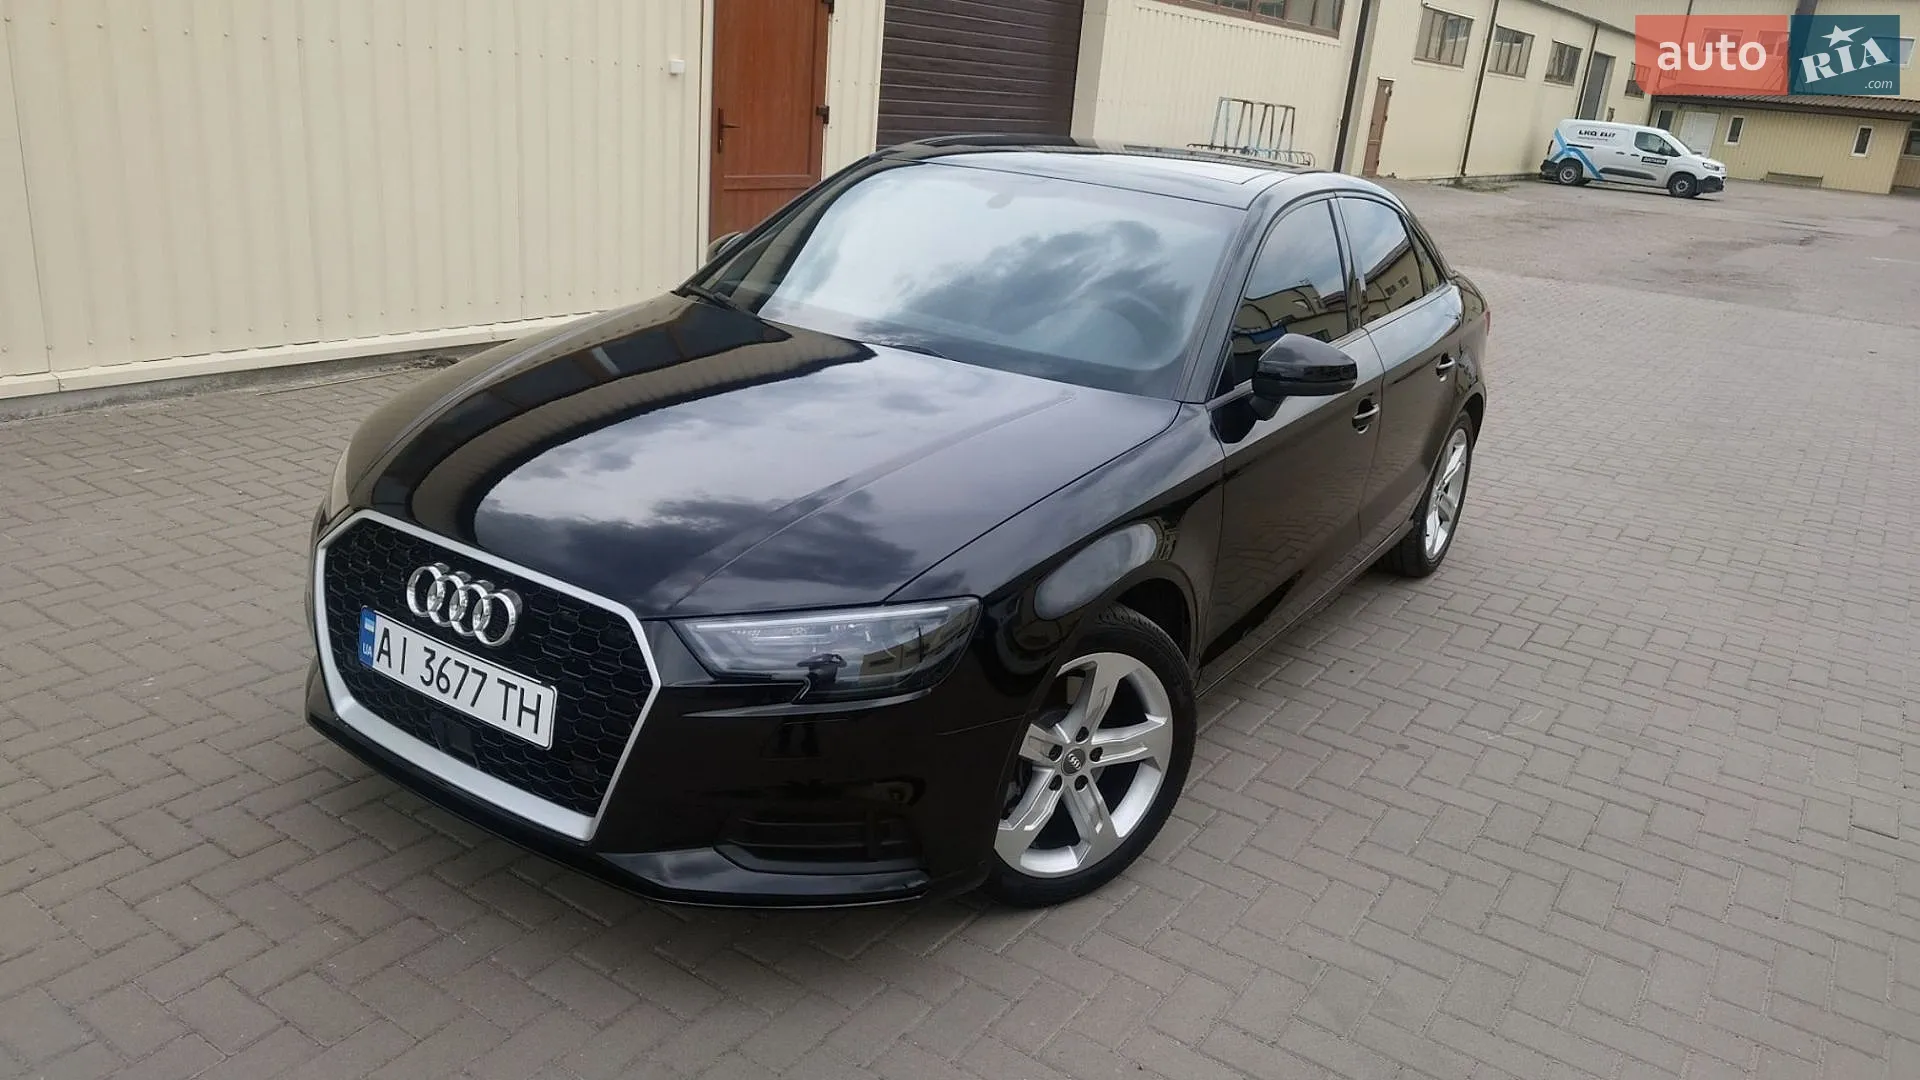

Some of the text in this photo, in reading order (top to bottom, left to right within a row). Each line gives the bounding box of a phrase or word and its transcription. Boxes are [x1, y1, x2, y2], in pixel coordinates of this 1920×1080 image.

[362, 643, 373, 657] UA
[376, 627, 542, 734] AI 3677 TH
